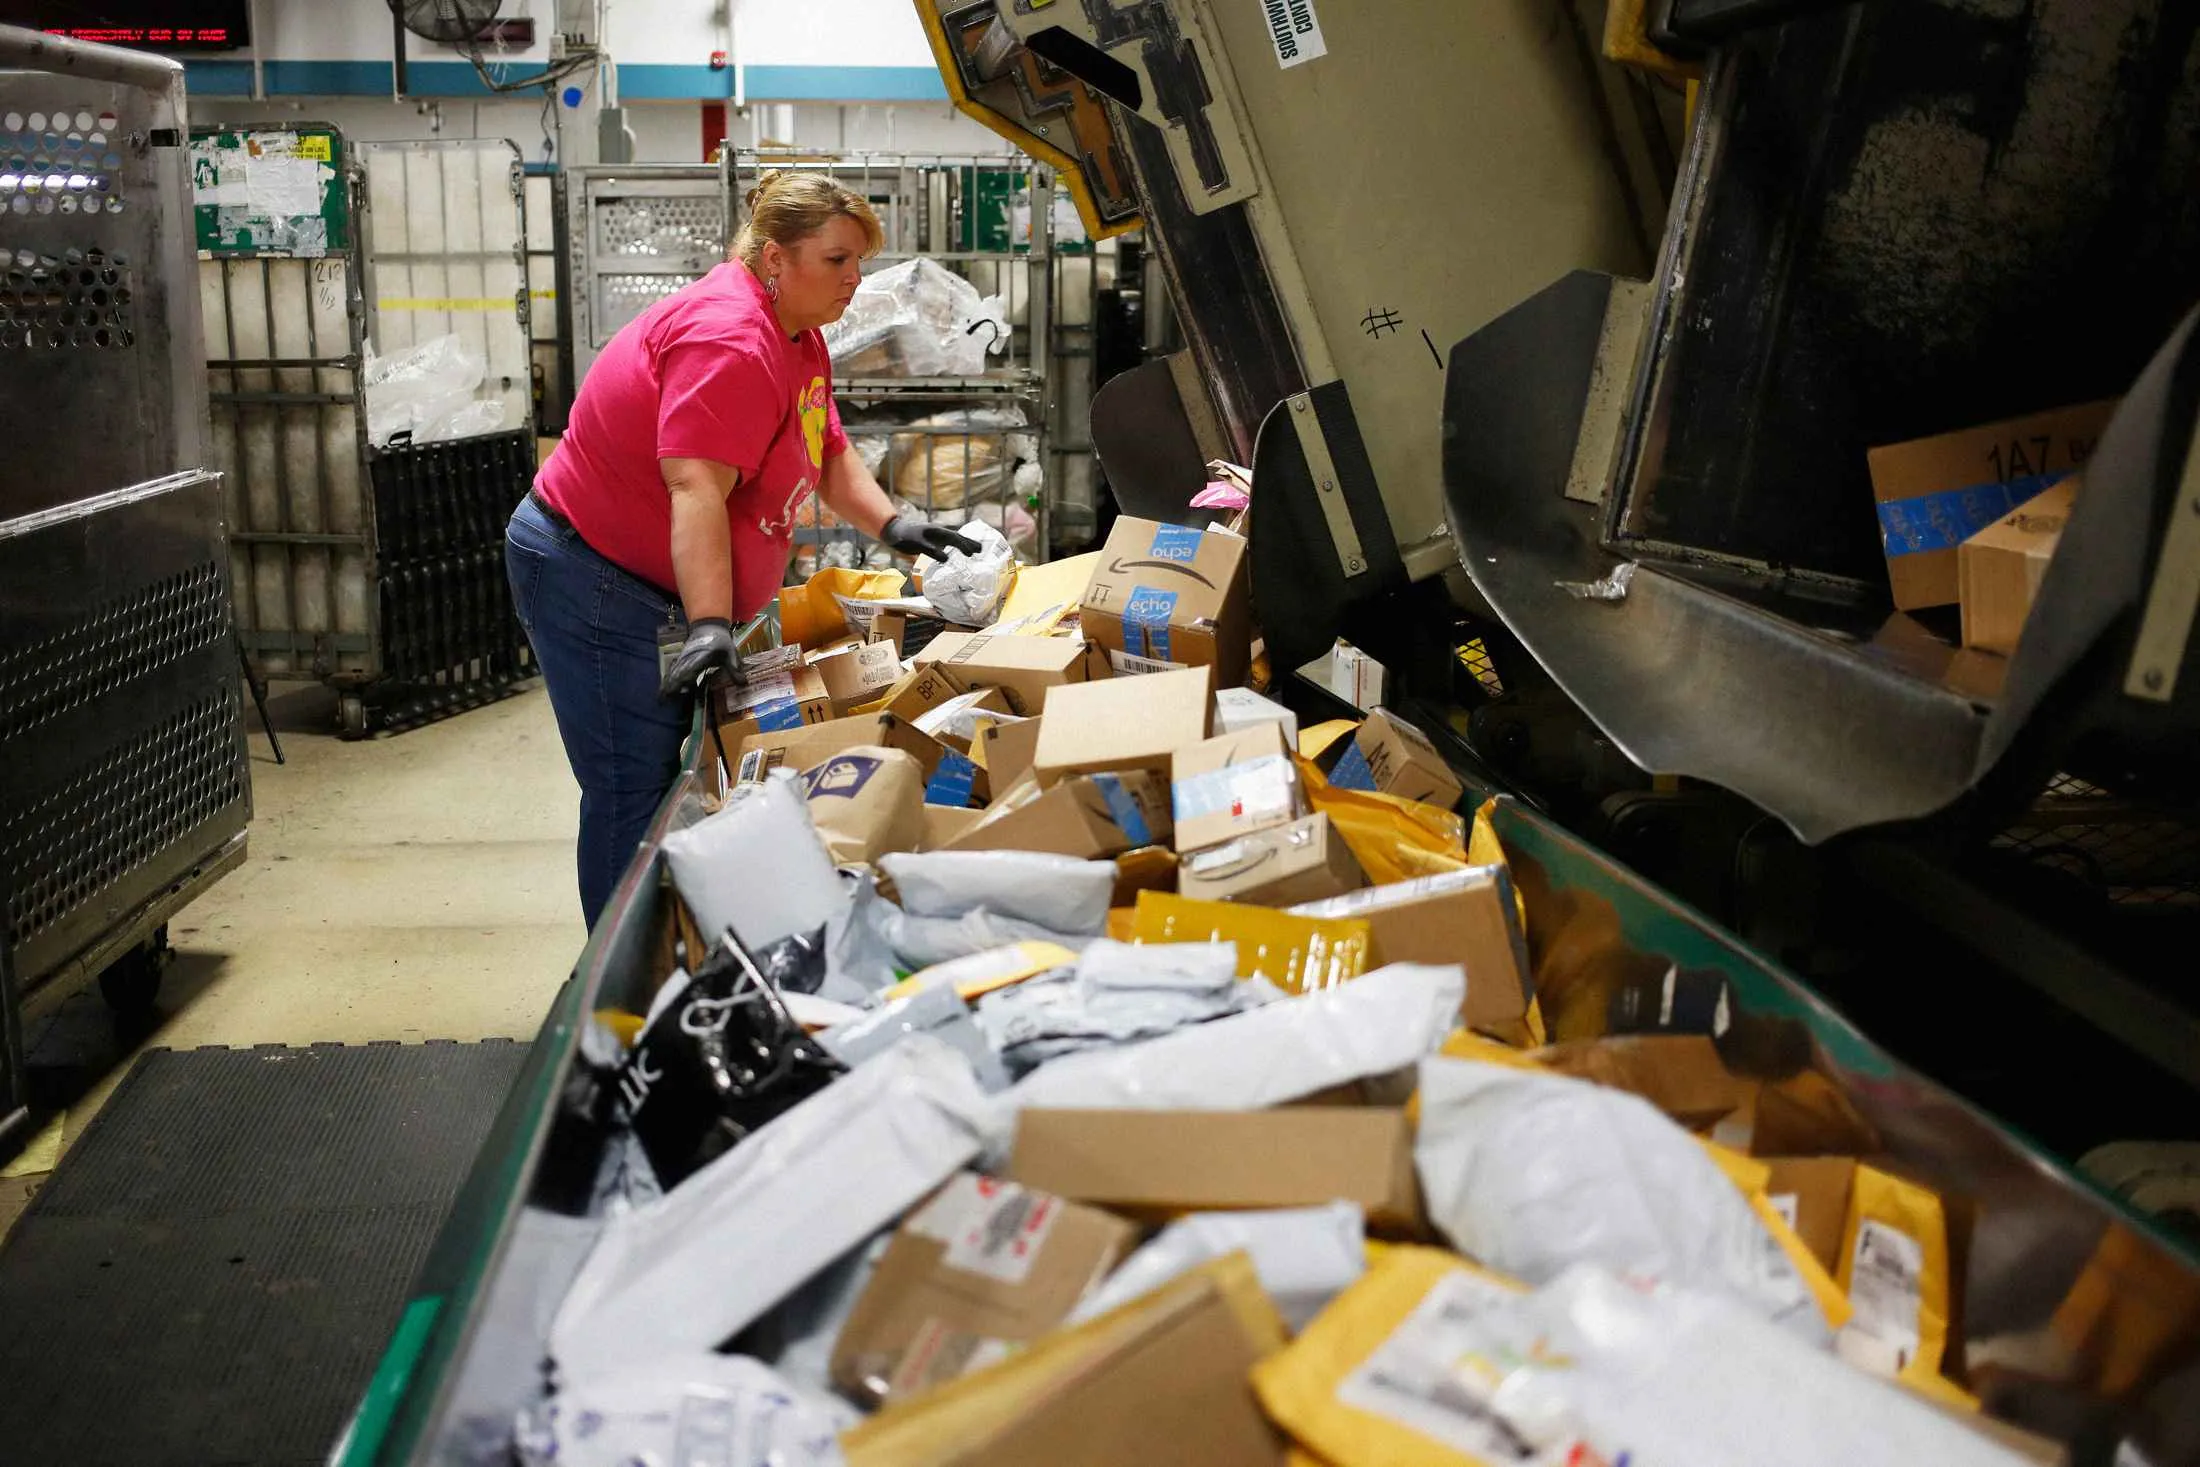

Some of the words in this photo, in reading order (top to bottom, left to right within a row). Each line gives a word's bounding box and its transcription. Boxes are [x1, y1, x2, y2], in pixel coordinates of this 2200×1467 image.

[1987, 435, 2051, 483] 1A7
[1152, 546, 1193, 560] echo
[1130, 597, 1171, 613] echo
